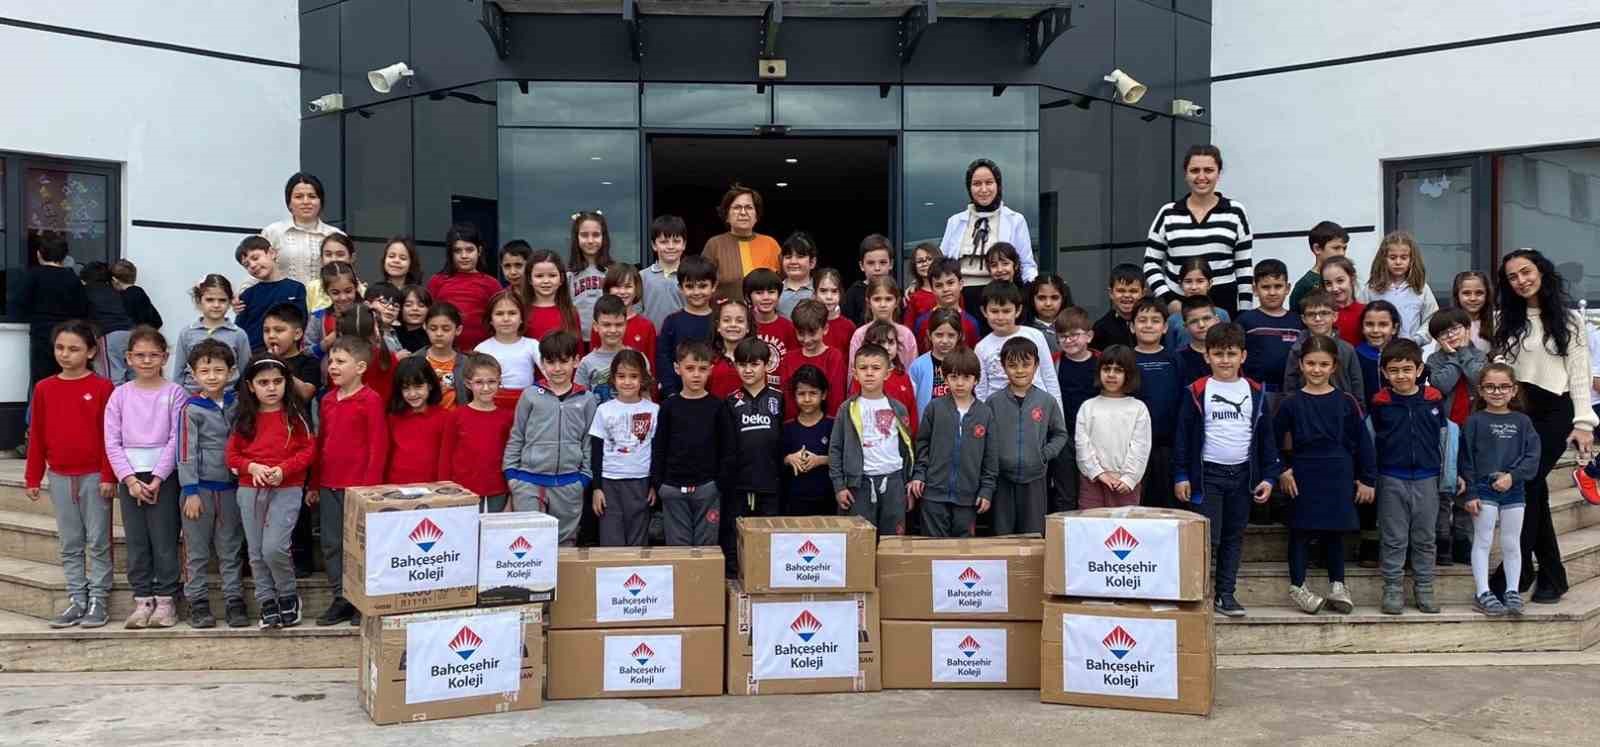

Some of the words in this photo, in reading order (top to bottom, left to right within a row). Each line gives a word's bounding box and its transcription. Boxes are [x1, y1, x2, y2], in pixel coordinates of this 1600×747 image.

[742, 413, 771, 425] beko
[391, 551, 460, 568] Bahçeşehir
[496, 559, 543, 568] Bahçeşehir
[785, 562, 831, 572] Bahçeşehir
[1088, 561, 1158, 574] Bahçeşehir
[408, 567, 444, 581] Koleji
[506, 569, 531, 579] Koleji
[796, 573, 820, 582] Koleji
[1105, 575, 1141, 589] Koleji
[948, 589, 993, 599] Bahçeşehir
[612, 596, 658, 606] Bahçeşehir
[958, 599, 982, 608] Koleji
[623, 606, 648, 616] Koleji
[775, 642, 838, 656] Bahçeşehir
[431, 657, 500, 677] Bahçeşehir
[791, 656, 824, 670] Koleji
[947, 658, 992, 667] Bahçeşehir
[1086, 659, 1155, 674] Bahçeşehir
[619, 665, 666, 675] Bahçeşehir
[958, 668, 981, 677] Koleji
[448, 673, 483, 689] Koleji
[630, 676, 654, 685] Koleji
[1104, 674, 1139, 689] Koleji
